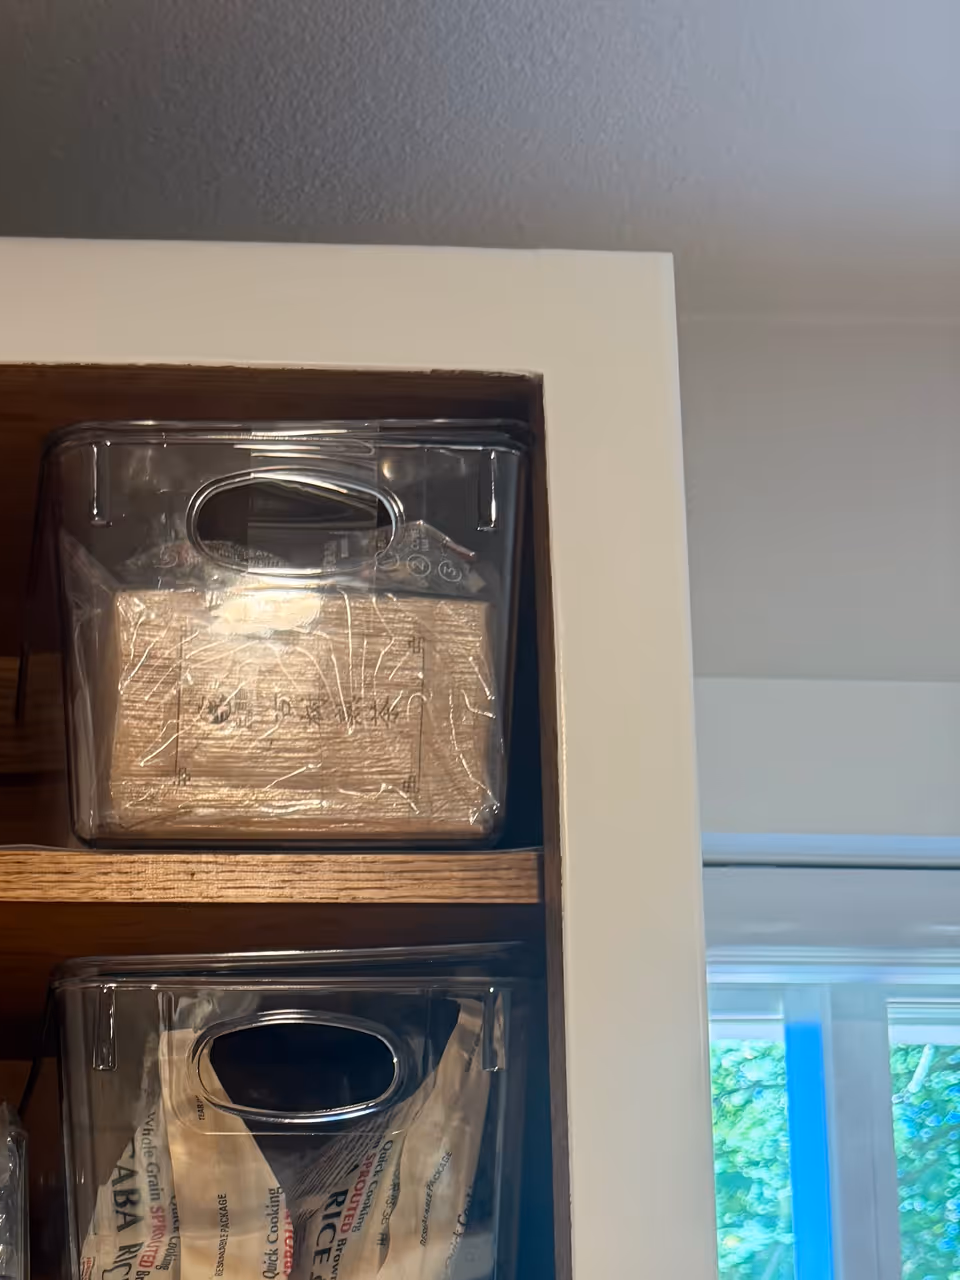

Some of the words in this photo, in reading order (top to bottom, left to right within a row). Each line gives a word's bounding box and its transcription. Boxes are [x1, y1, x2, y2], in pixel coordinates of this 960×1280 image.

[145, 1161, 164, 1202] Grain
[372, 1139, 394, 1178] Quick
[427, 1151, 453, 1193] PACKAGE
[216, 1193, 230, 1234] PACKAGE
[263, 1185, 282, 1245] Cooking
[339, 1151, 377, 1234] SPROUTED
[351, 1180, 379, 1233] Cooking
[136, 1204, 167, 1269] SPROUTED
[312, 1188, 350, 1267] RICE
[262, 1247, 280, 1280] Quick
